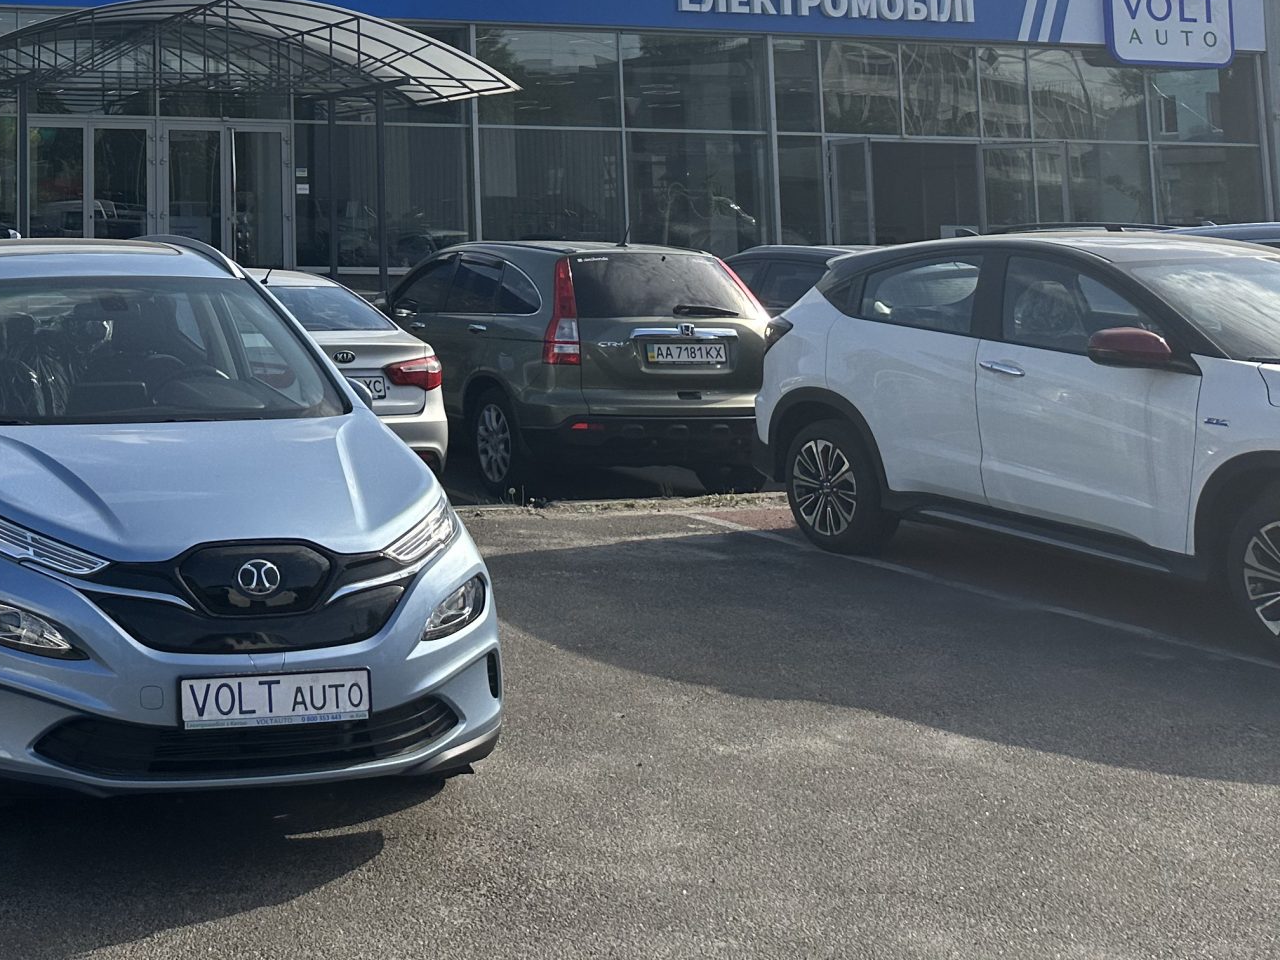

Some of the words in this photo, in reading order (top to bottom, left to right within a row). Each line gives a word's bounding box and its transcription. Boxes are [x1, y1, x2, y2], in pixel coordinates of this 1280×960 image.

[1129, 27, 1218, 48] AUTO
[335, 352, 354, 361] KIA
[656, 346, 673, 359] AA
[676, 346, 702, 359] 7181
[705, 346, 724, 359] KX
[189, 679, 281, 717] VOLT
[291, 682, 364, 712] AUTO
